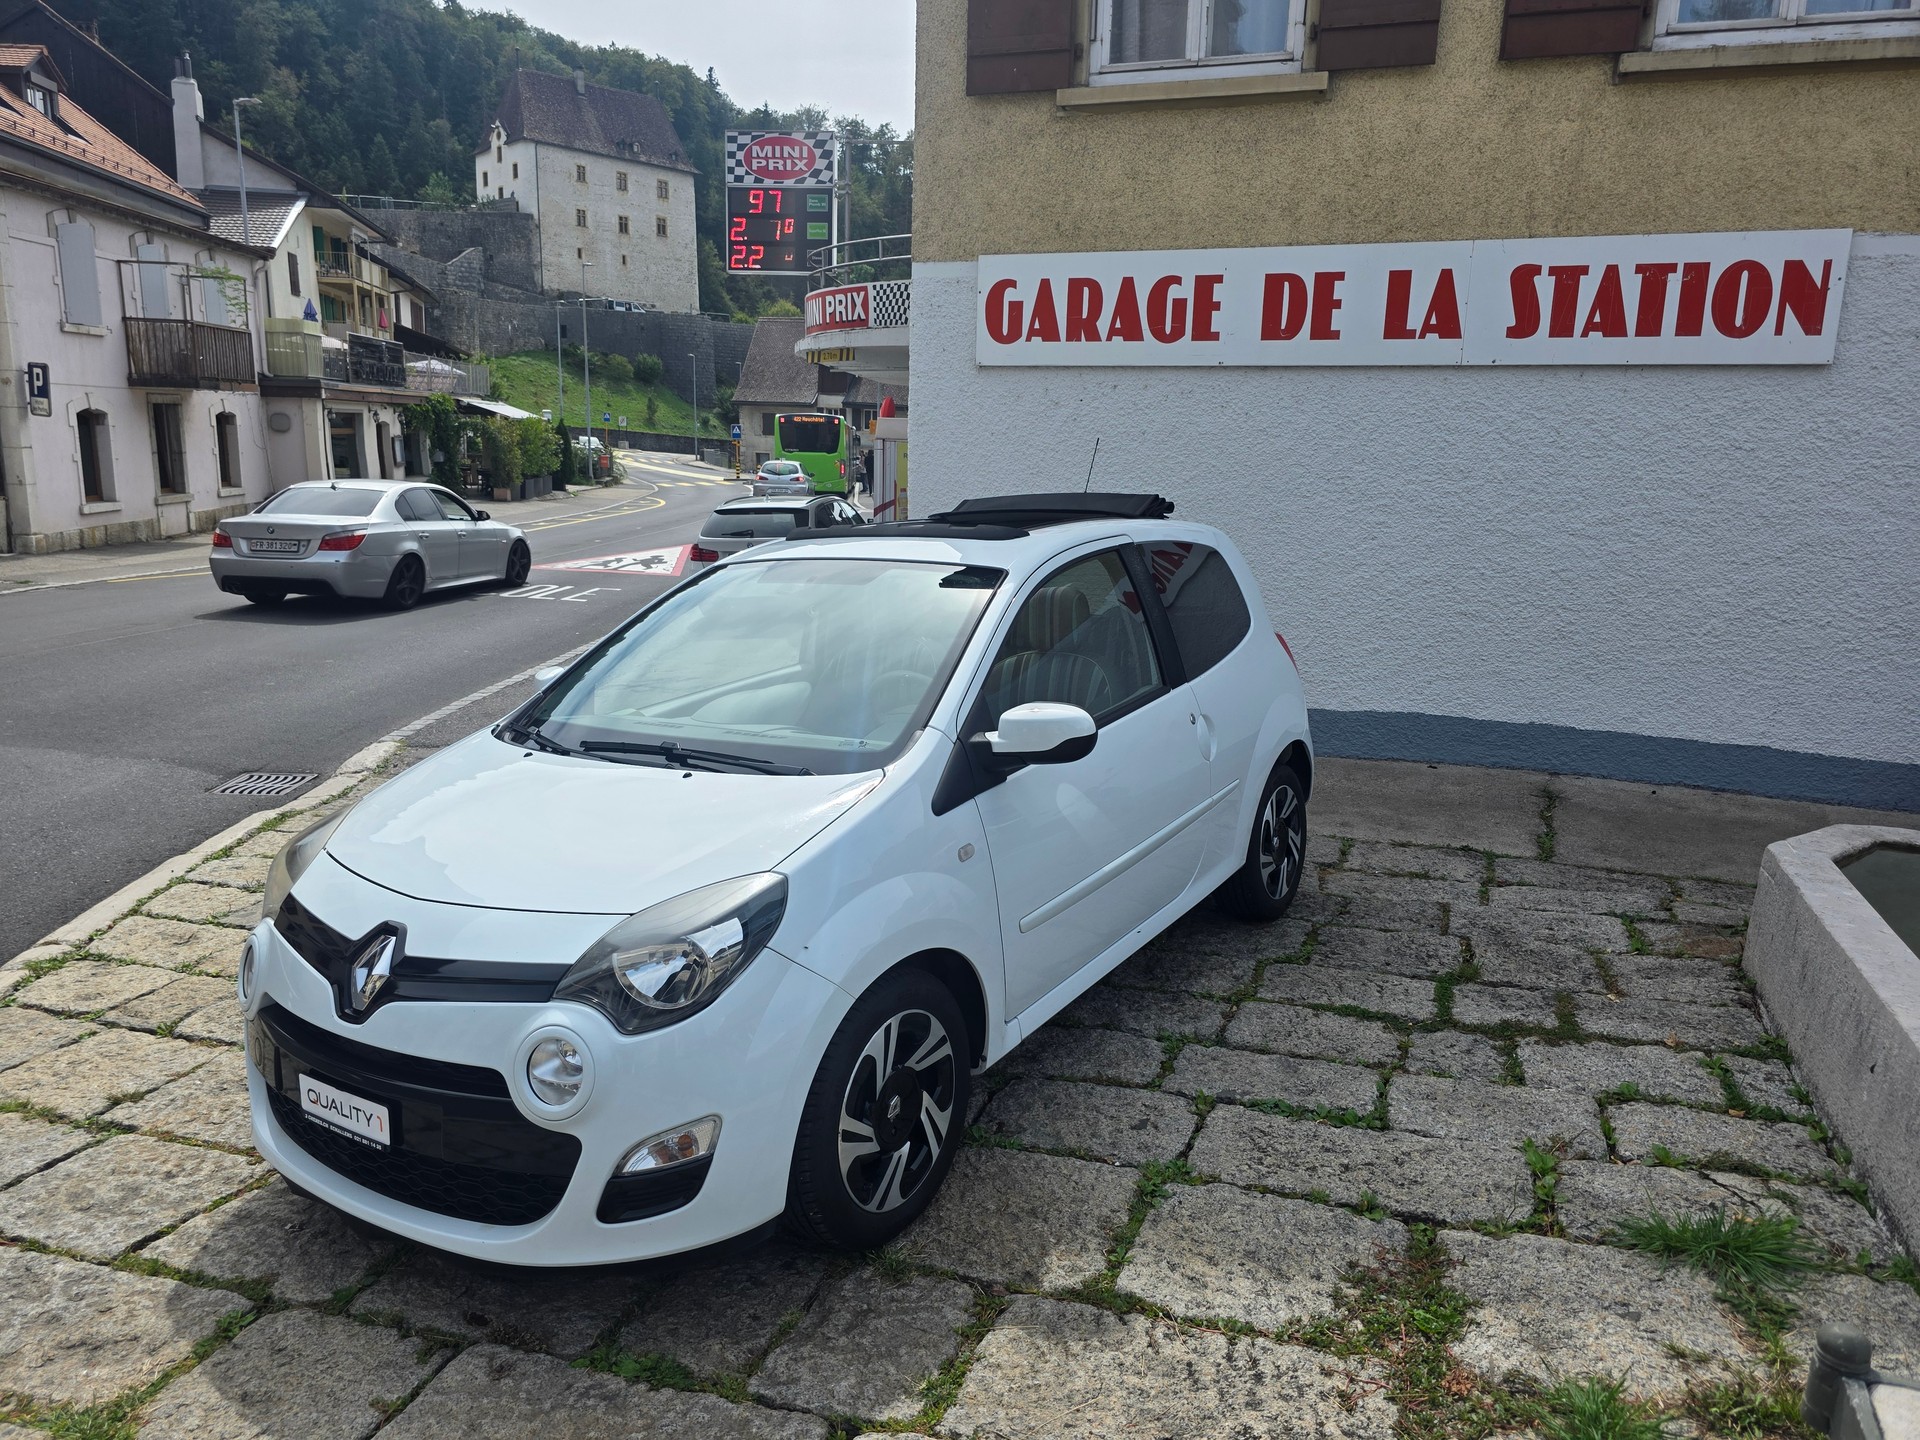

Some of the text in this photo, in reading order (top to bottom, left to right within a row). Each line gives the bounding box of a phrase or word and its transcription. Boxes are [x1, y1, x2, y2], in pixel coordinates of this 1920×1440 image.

[751, 145, 808, 158] MINI
[751, 159, 808, 171] PRIX
[825, 291, 867, 324] PRIX
[985, 259, 1833, 344] GARAGE DE LA STATION
[33, 368, 43, 395] P
